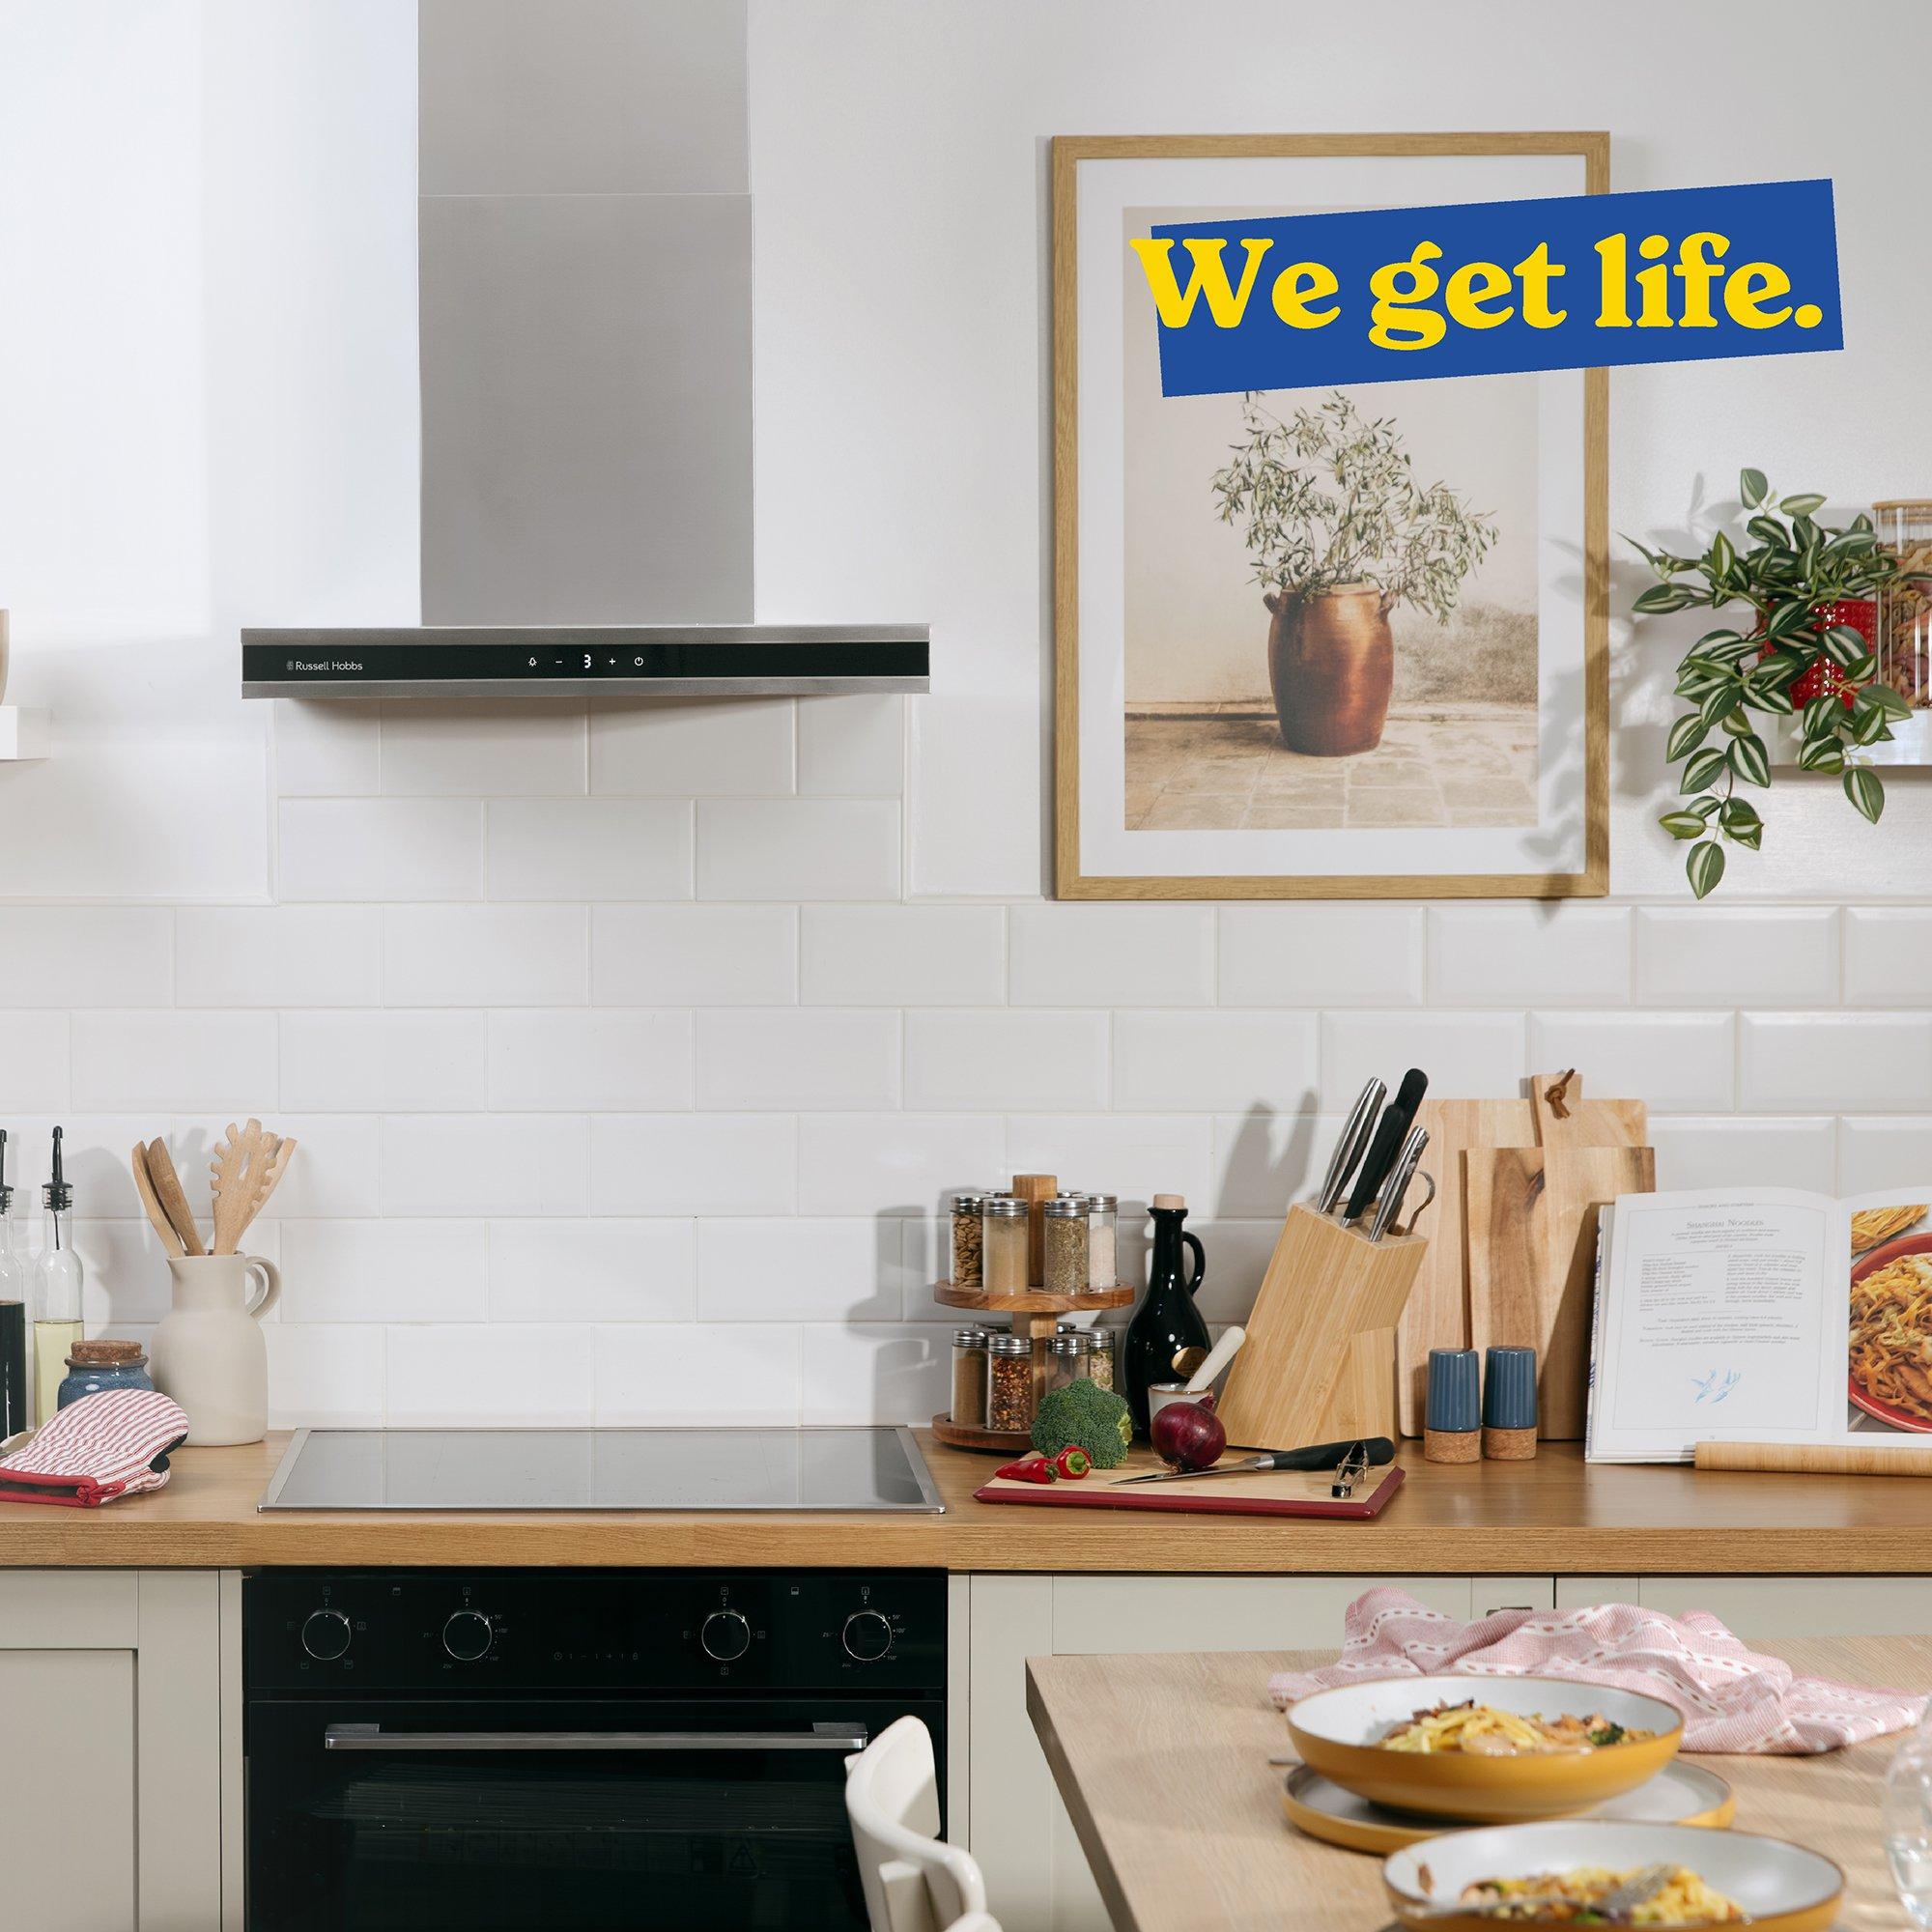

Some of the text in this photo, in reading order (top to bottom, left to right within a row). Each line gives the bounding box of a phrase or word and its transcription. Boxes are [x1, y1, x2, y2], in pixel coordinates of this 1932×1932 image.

[296, 661, 363, 671] Russell Hobbs
[583, 654, 591, 668] 3
